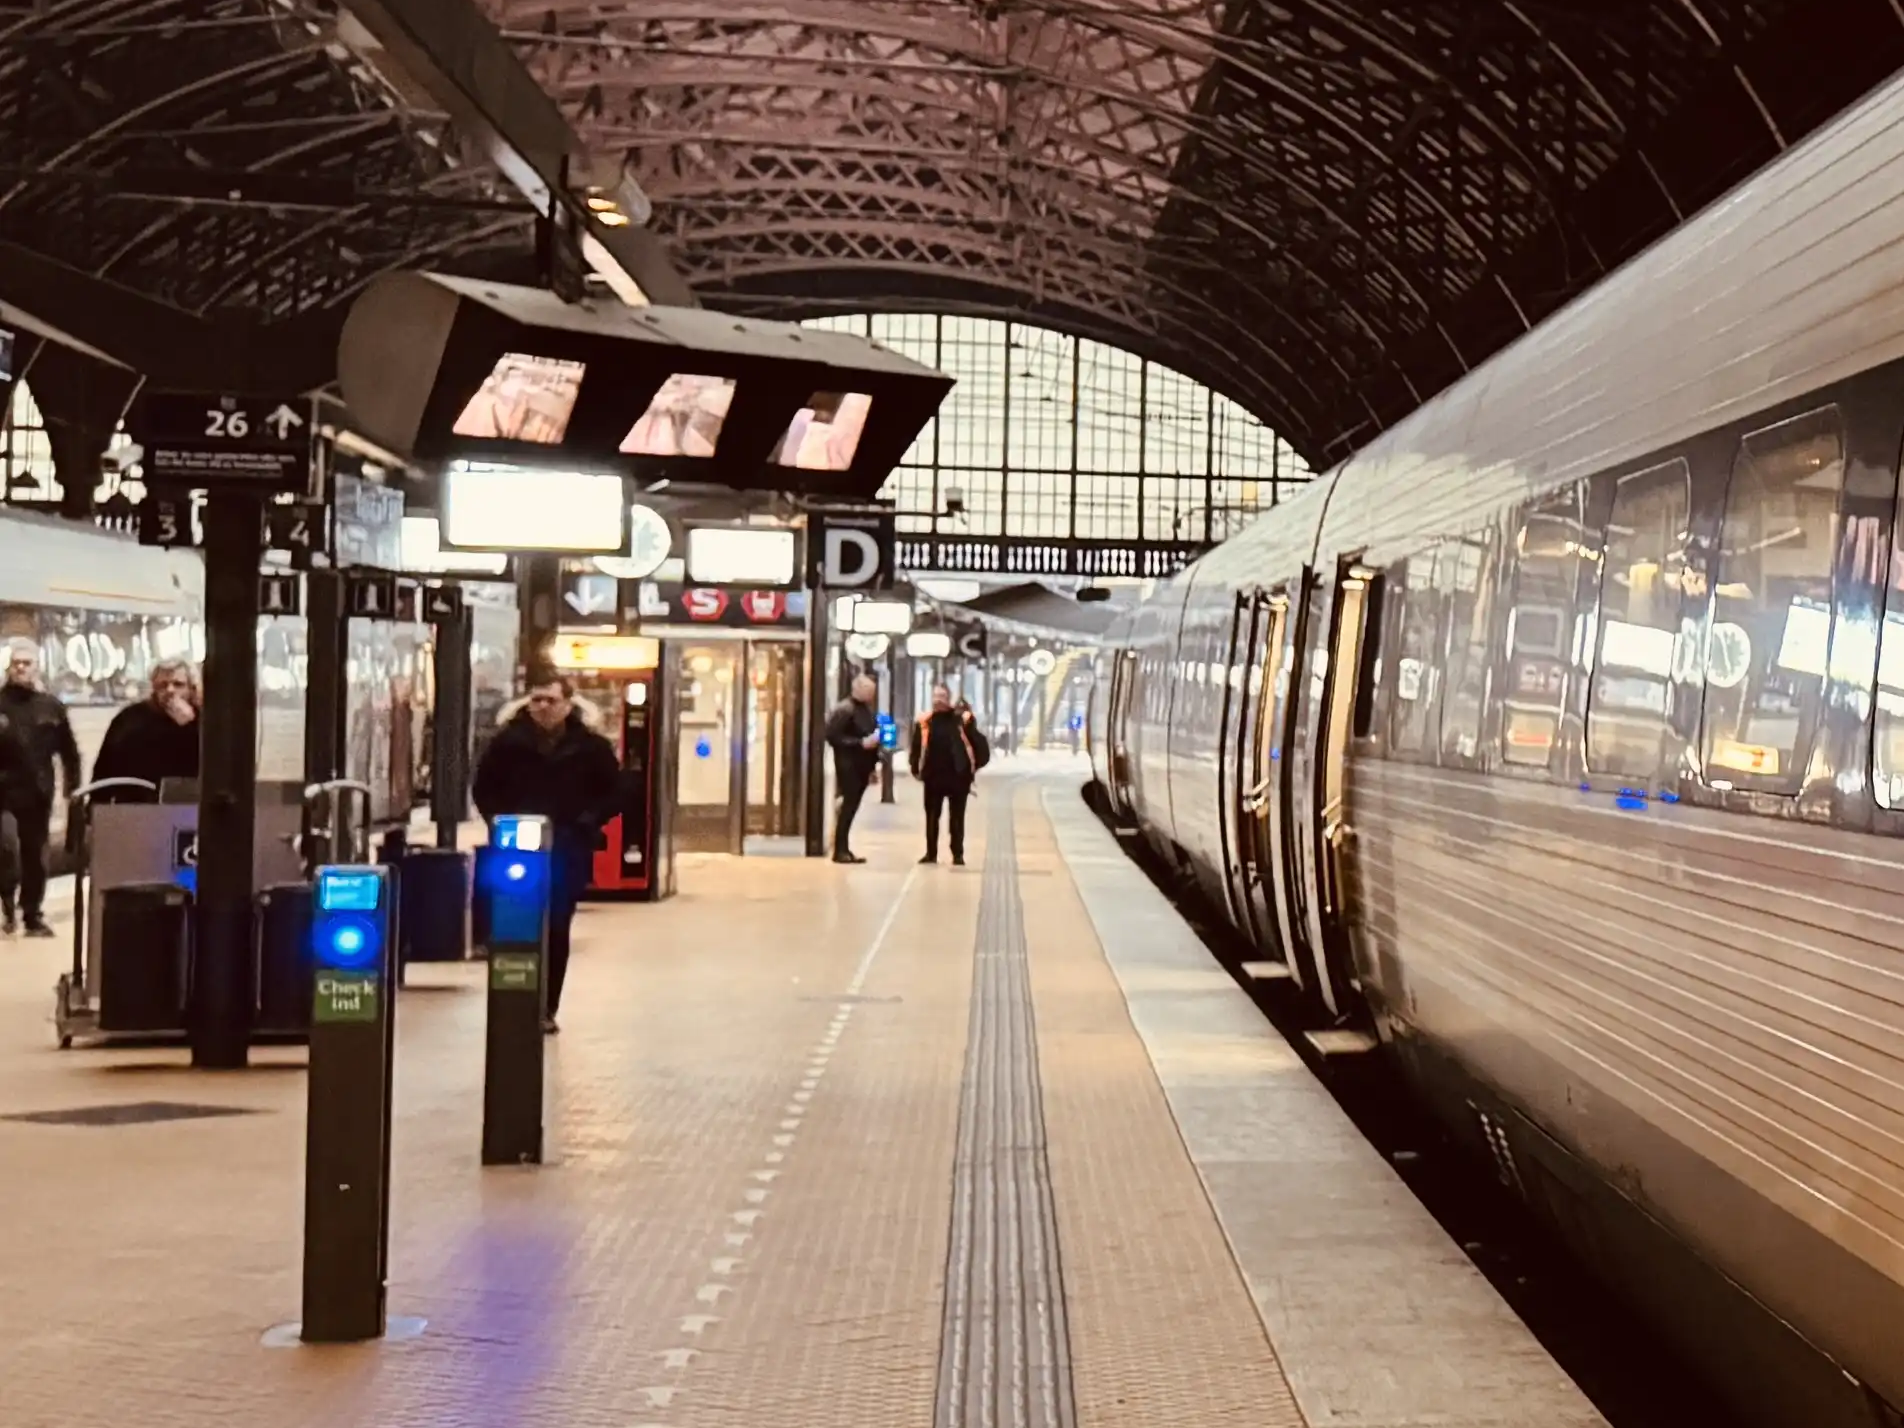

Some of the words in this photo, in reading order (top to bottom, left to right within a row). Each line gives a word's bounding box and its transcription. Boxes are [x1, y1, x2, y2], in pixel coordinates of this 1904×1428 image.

[205, 410, 248, 438] 26
[157, 515, 177, 542] 3
[289, 521, 309, 547] 4
[824, 529, 879, 586] D
[690, 588, 719, 615] S
[960, 633, 982, 657] C
[317, 979, 376, 996] Check
